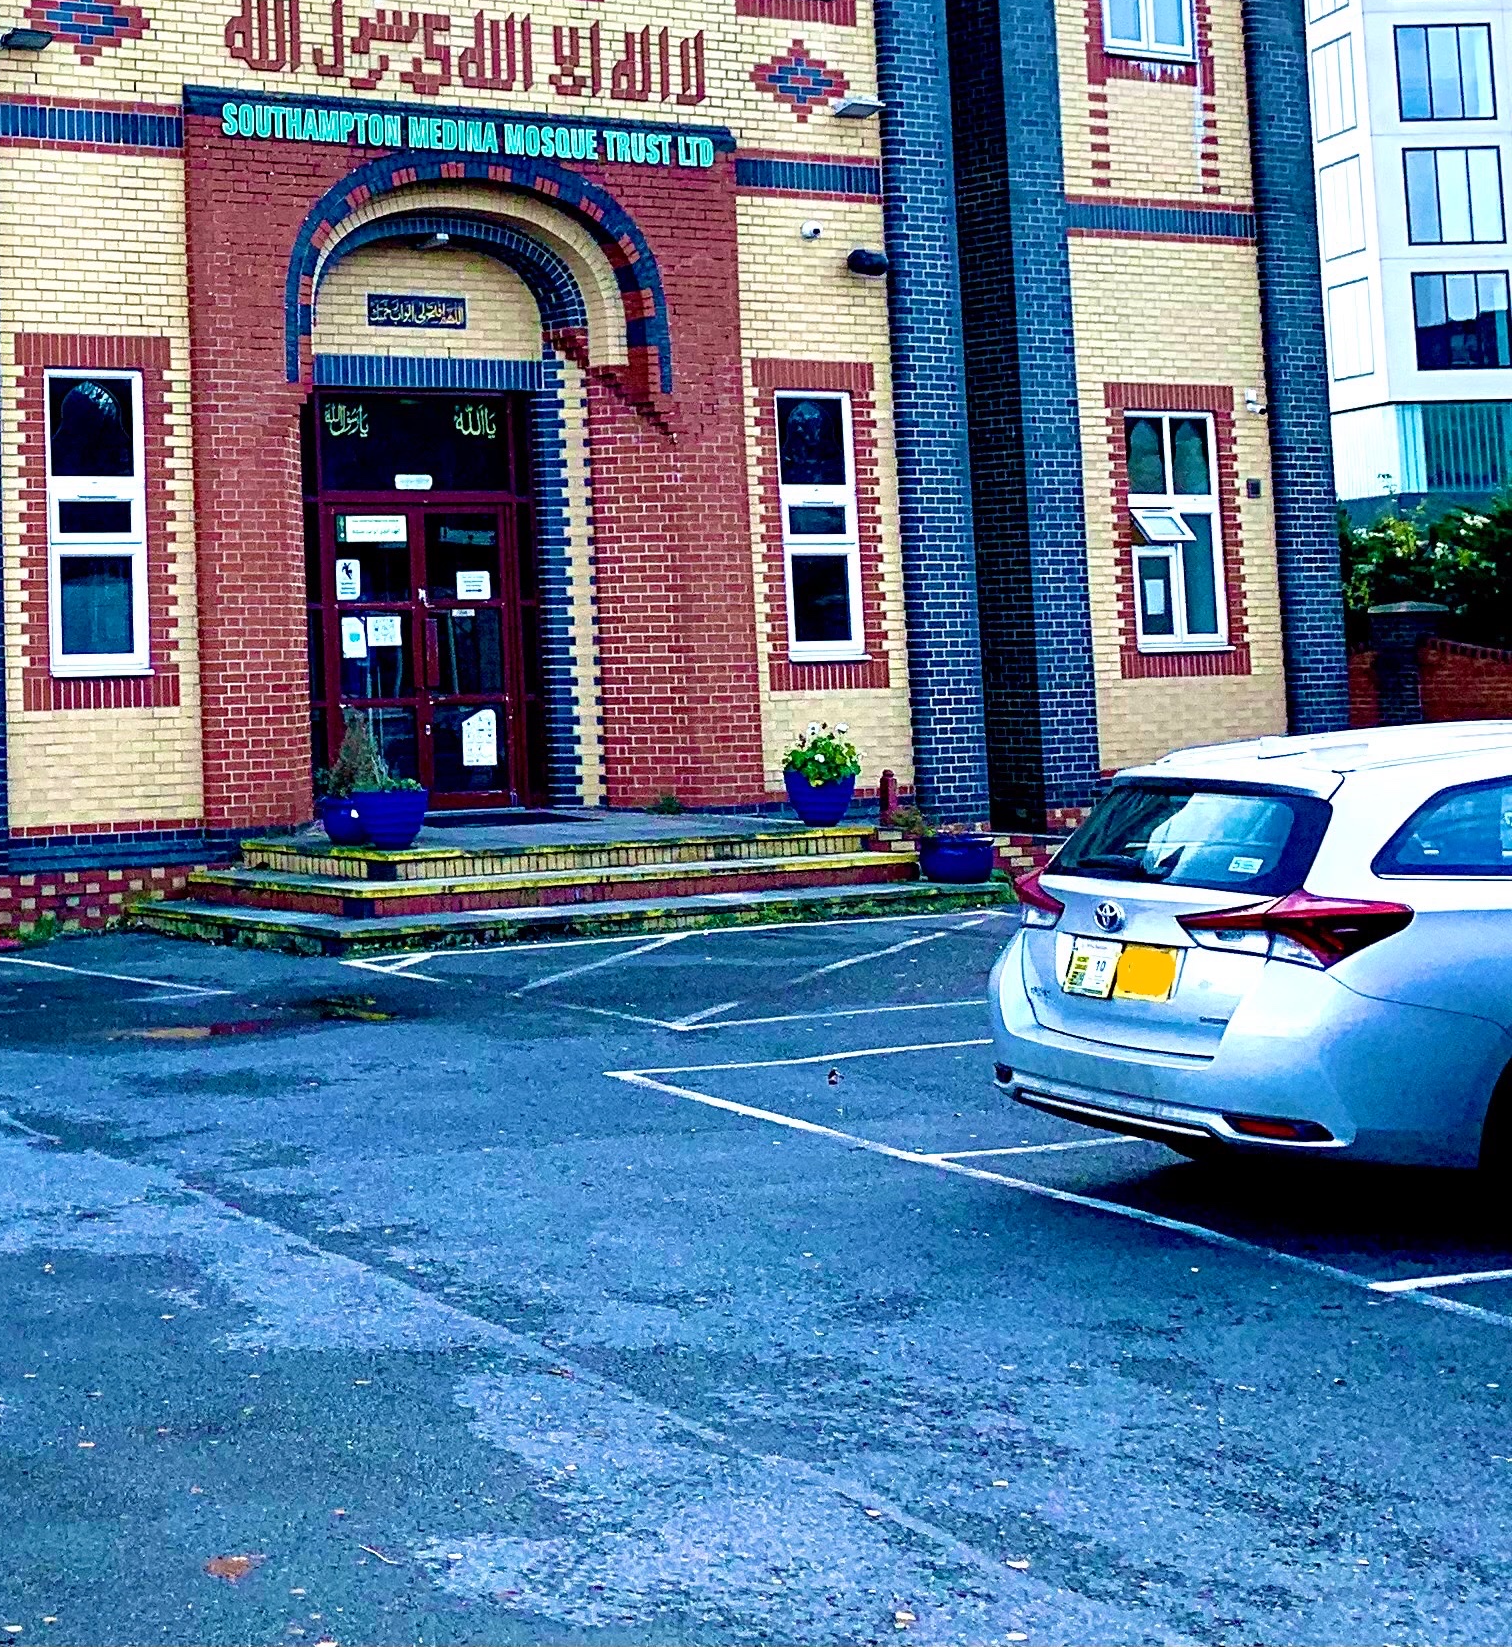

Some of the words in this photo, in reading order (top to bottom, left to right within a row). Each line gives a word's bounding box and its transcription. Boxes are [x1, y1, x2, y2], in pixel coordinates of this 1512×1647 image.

[222, 103, 401, 147] SOUTHAMPTON
[408, 117, 499, 154] MEDINA
[504, 123, 599, 161] MOSQUE
[603, 130, 672, 165] TRUST
[678, 136, 715, 168] LTD
